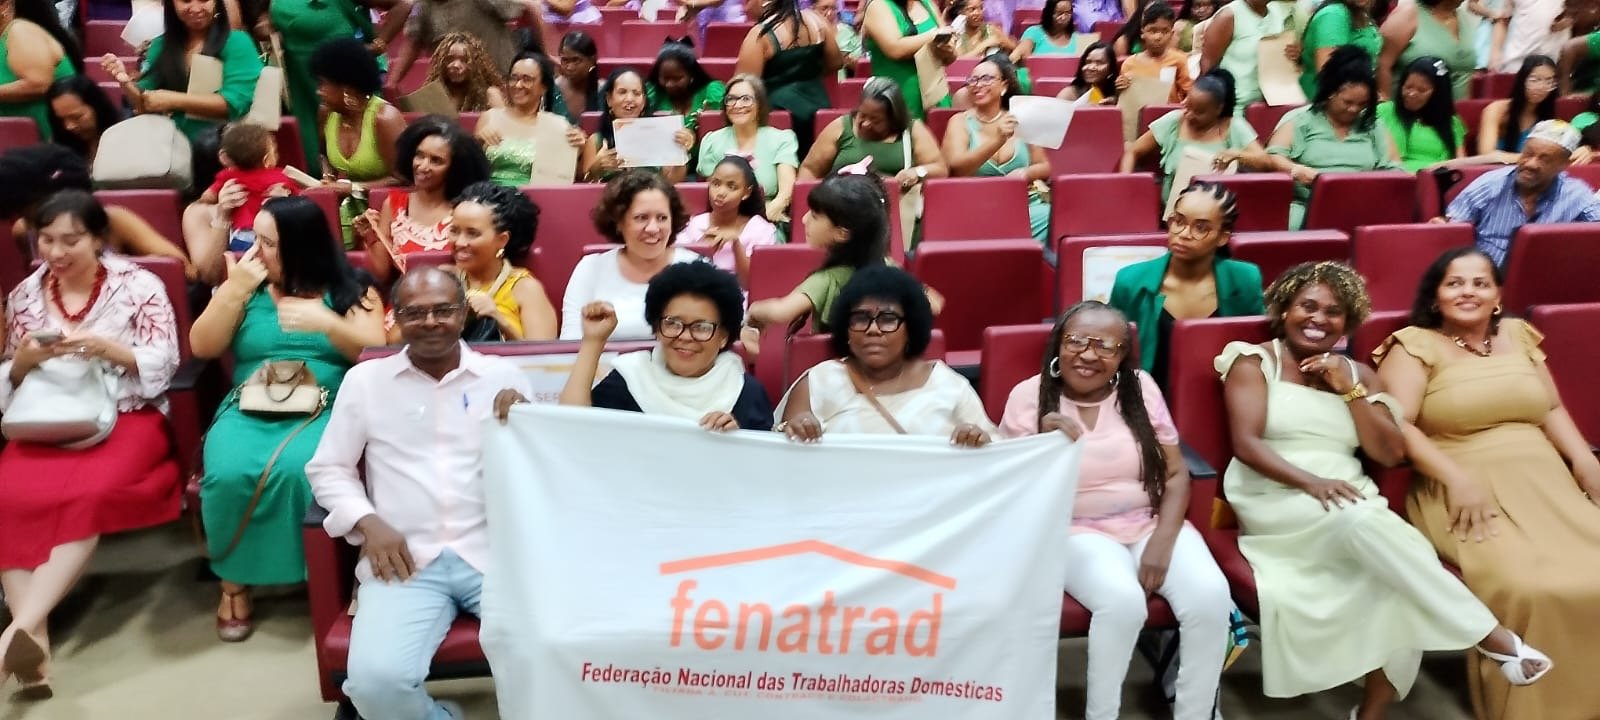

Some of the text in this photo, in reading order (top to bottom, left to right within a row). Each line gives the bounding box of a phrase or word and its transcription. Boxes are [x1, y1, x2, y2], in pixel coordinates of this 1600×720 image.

[669, 579, 943, 658] fenatrad
[581, 662, 672, 688] Federação
[677, 667, 752, 690] Nacional
[757, 671, 785, 691] das
[791, 672, 905, 695] Trabalhadoras
[910, 676, 1004, 702] Domésticas
